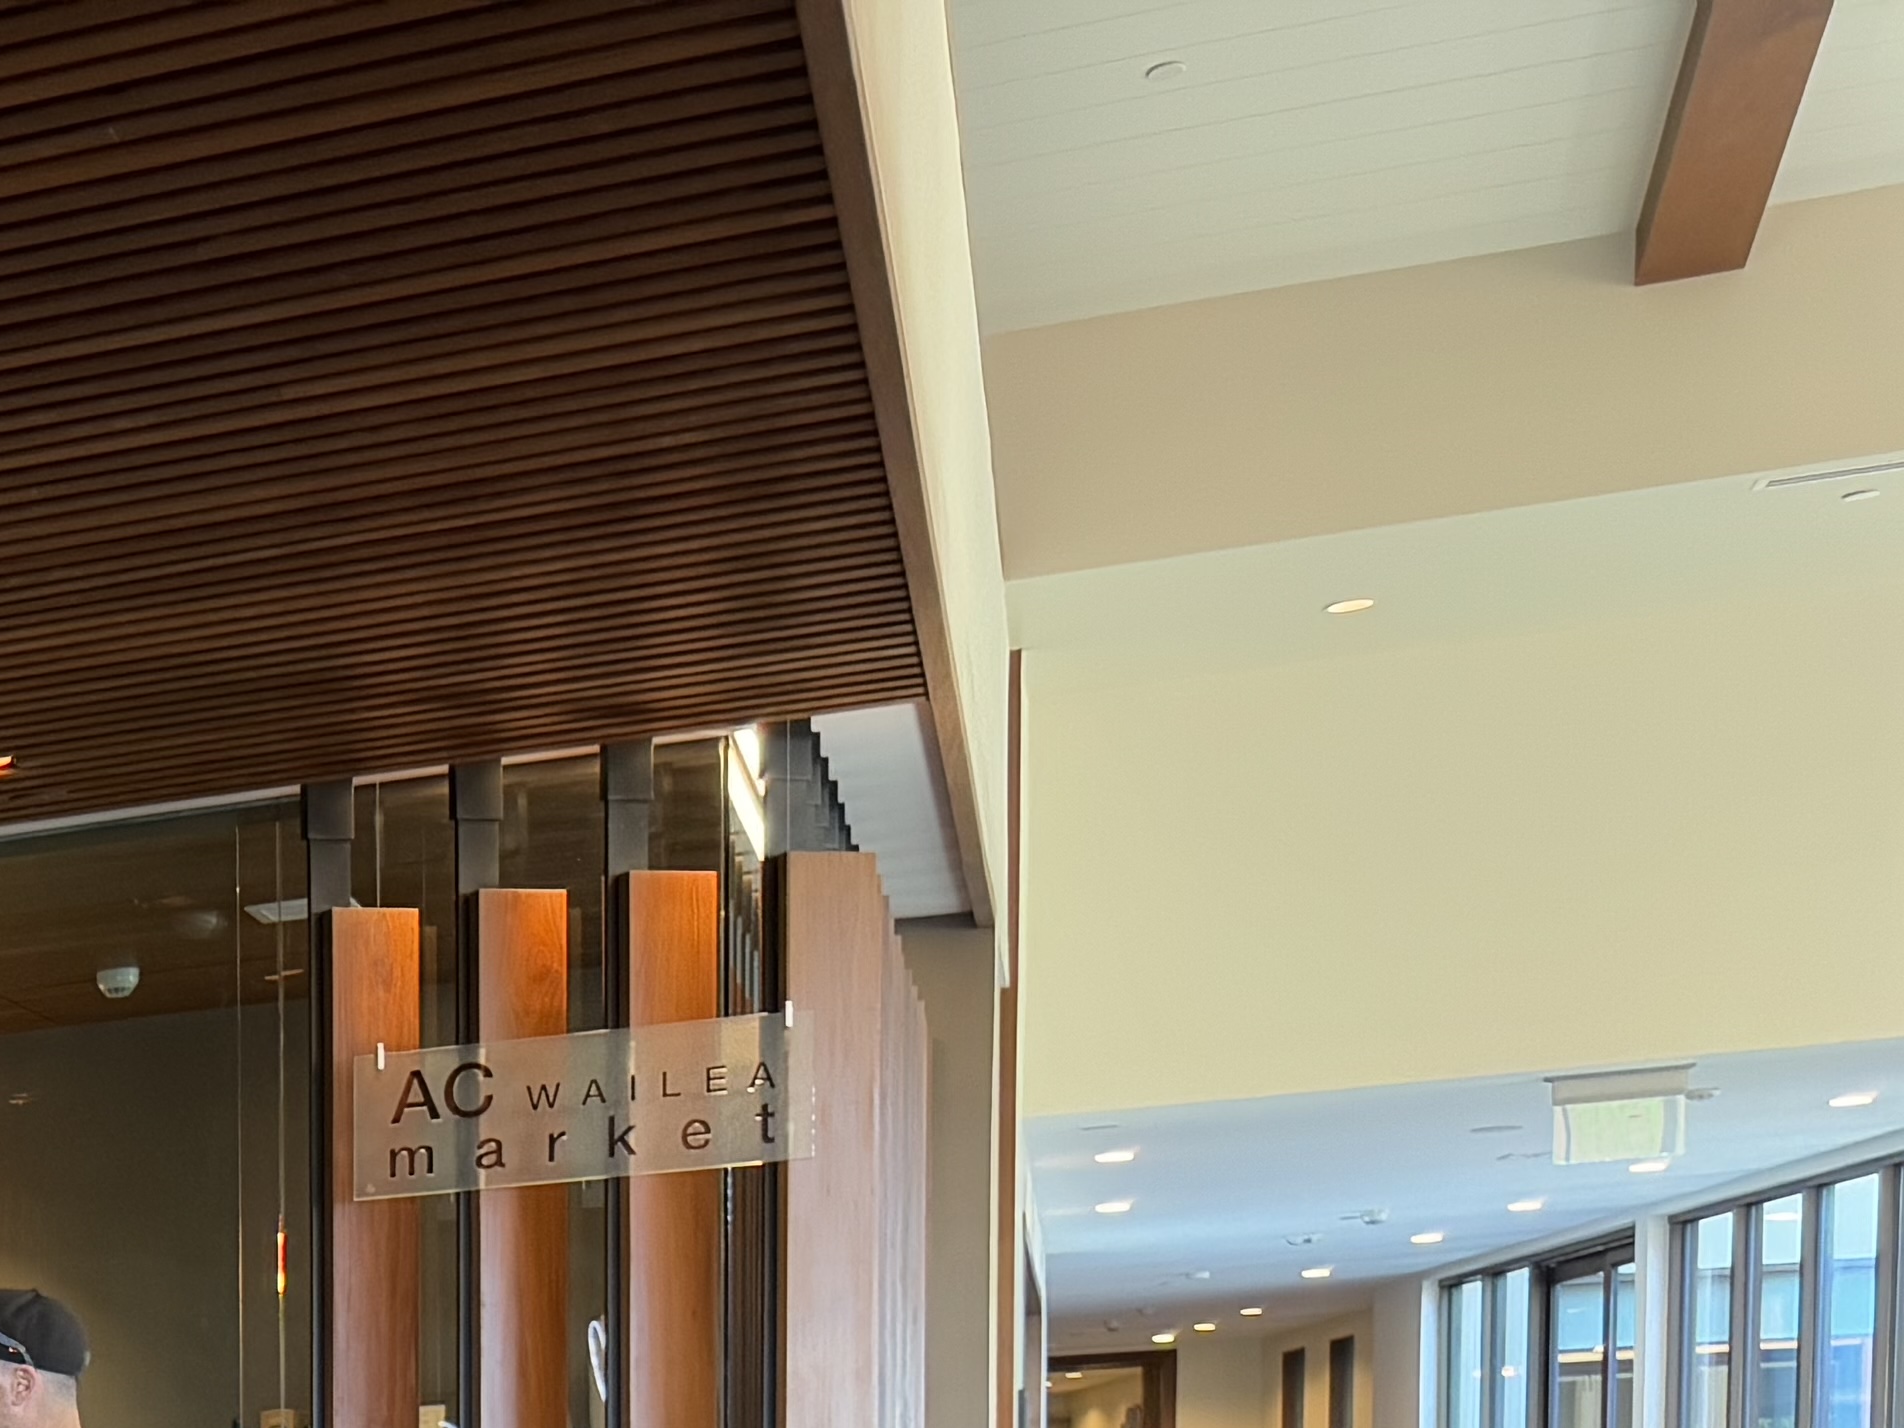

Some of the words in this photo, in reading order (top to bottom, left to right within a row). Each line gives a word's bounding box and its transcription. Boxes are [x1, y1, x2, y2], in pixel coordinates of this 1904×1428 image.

[390, 1061, 494, 1124] AC
[526, 1061, 776, 1111] WAILEA
[389, 1103, 776, 1178] market
